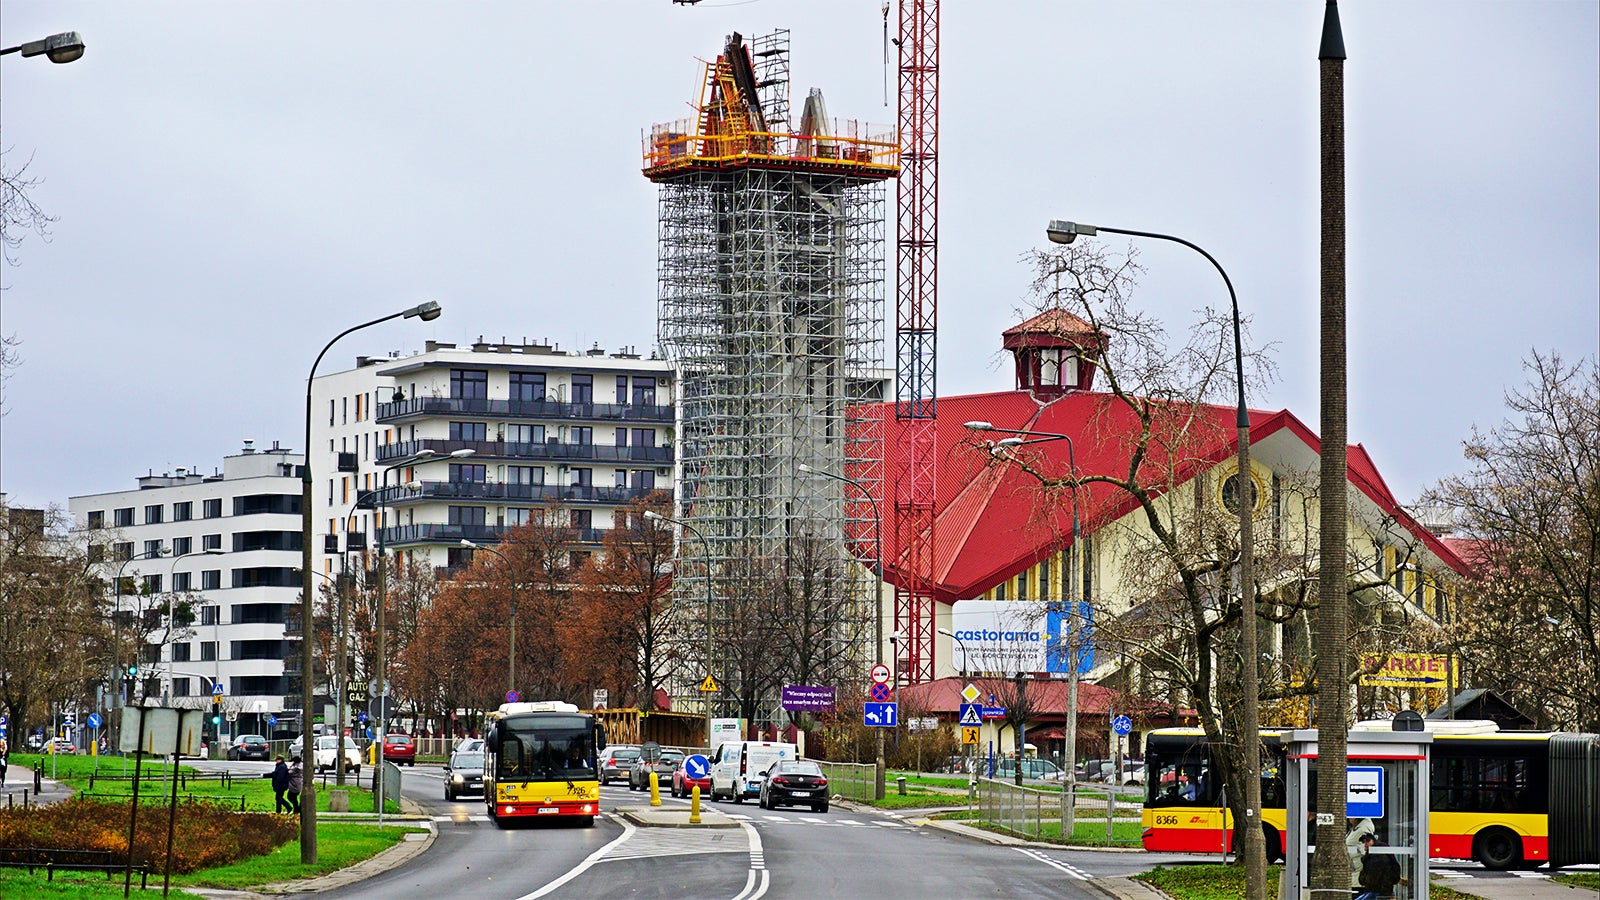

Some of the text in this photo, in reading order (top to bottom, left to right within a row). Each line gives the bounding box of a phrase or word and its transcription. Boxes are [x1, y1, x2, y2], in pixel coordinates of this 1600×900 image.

[955, 629, 1040, 642] castorama
[347, 681, 369, 691] AUTO
[349, 692, 366, 702] GAZ
[1156, 815, 1178, 825] 8366
